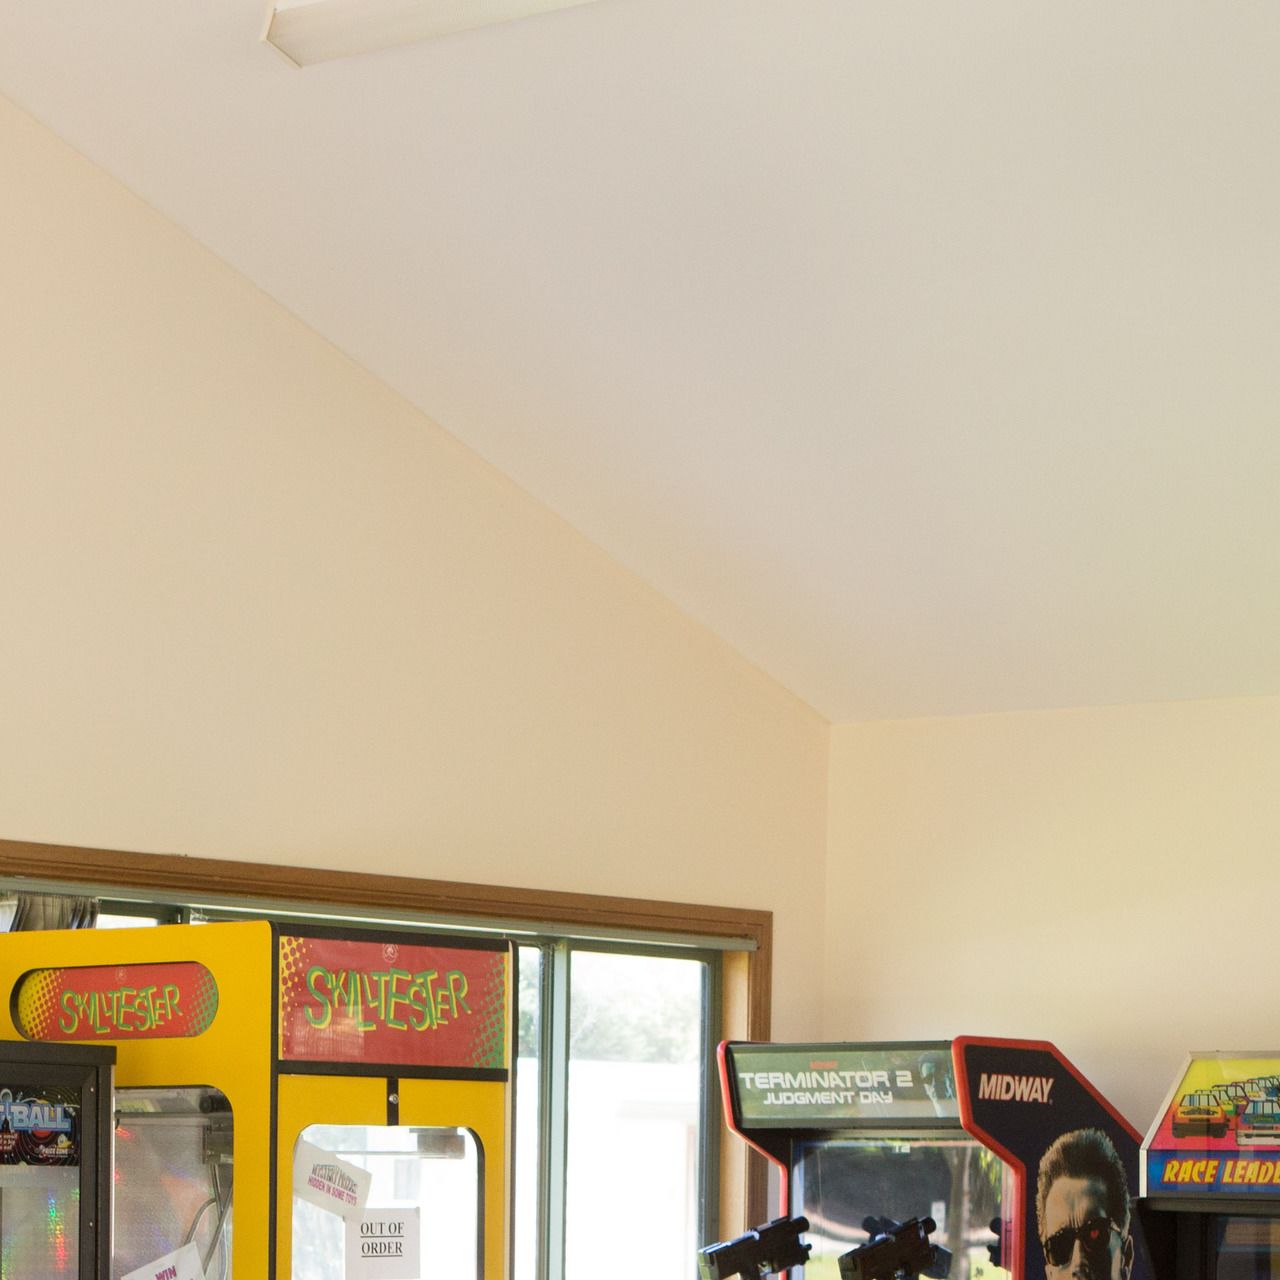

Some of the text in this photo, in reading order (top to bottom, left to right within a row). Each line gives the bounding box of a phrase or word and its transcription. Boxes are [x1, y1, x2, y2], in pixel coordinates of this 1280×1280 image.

[738, 1070, 913, 1089] TERMINATOR 2
[978, 1072, 1055, 1103] MIDWAY
[763, 1091, 893, 1105] JUDGMENT DAY
[9, 1101, 72, 1131] BALL
[1162, 1159, 1218, 1185] RACE
[325, 1182, 332, 1195] IN
[360, 1222, 404, 1235] OUT OF
[361, 1241, 403, 1254] ORDER
